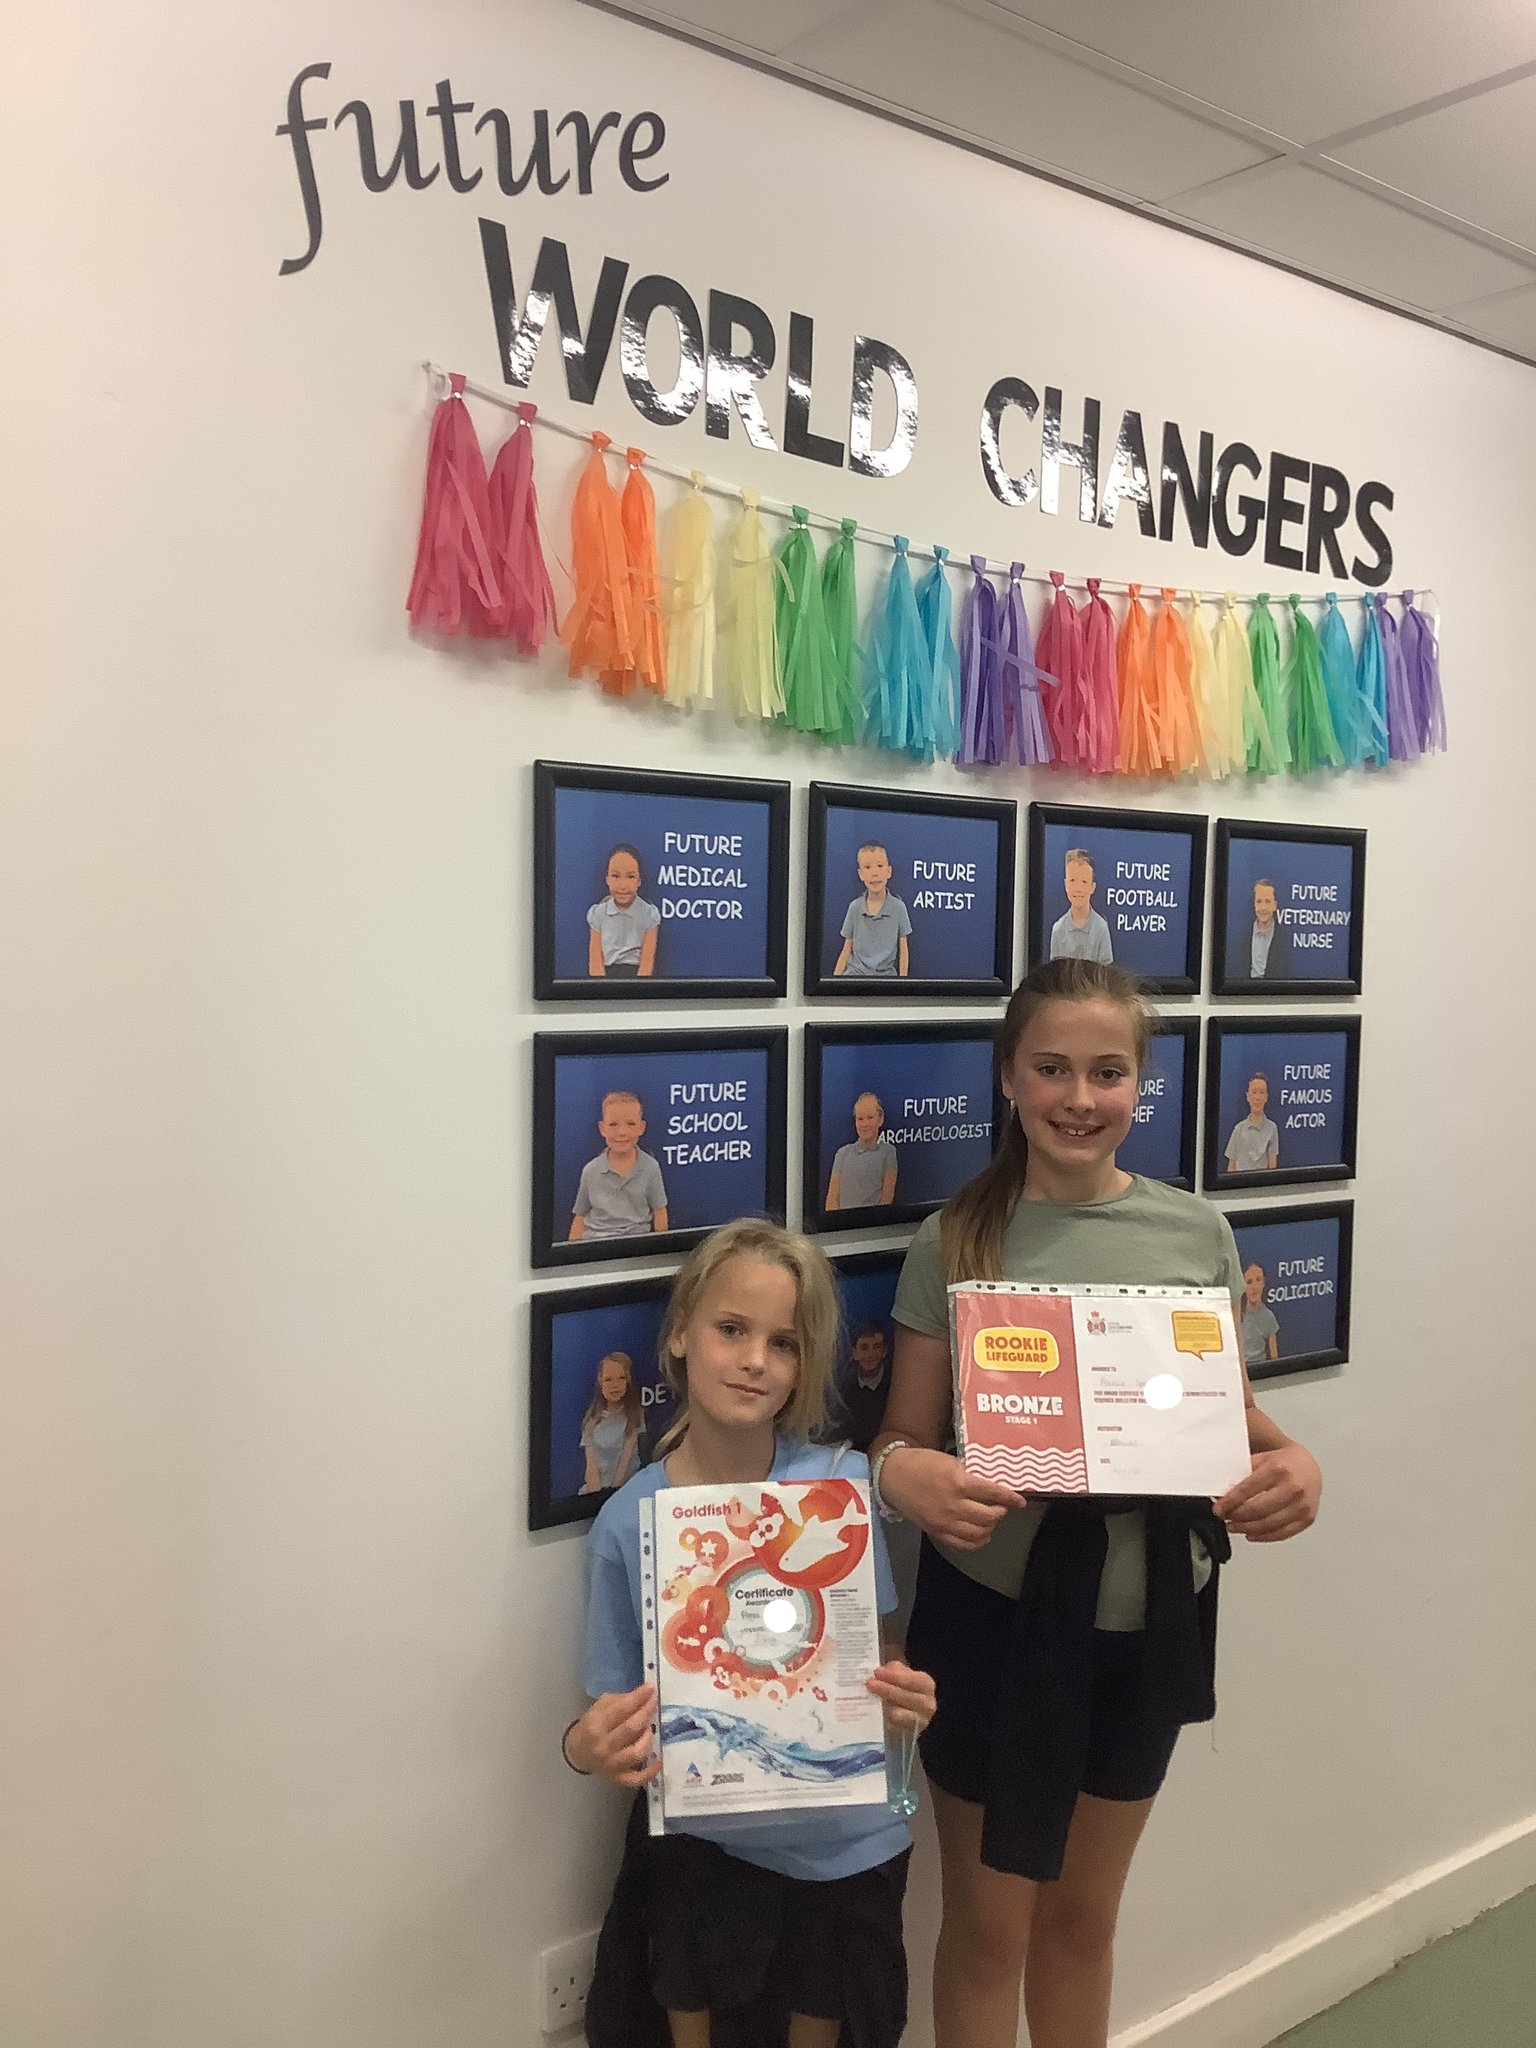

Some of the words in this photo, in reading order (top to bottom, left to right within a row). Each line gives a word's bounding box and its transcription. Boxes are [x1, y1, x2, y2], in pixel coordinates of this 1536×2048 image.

[275, 62, 669, 276] future
[478, 216, 919, 478] WORLD
[979, 377, 1394, 588] CHANGERS
[664, 831, 743, 857] FUTURE
[657, 865, 748, 889] MEDICAL
[913, 860, 976, 883] FUTURE
[1116, 861, 1171, 882] FUTURE
[913, 891, 975, 911] ARTIST
[1107, 887, 1178, 908] FOOTBALL
[1291, 883, 1338, 902] FUTURE
[661, 897, 743, 920] DOCTOR
[1276, 908, 1351, 926] VETERINARY
[1117, 913, 1166, 932] PLAYER
[1293, 932, 1334, 949] NURSE
[1284, 1063, 1332, 1081] FUTURE
[670, 1080, 747, 1105] FUTURE
[1138, 1078, 1165, 1096] URE
[1280, 1088, 1333, 1106] FAMOUS
[904, 1095, 968, 1118] FUTURE
[1131, 1105, 1155, 1123] HEF
[667, 1111, 748, 1135] SCHOOL
[1285, 1112, 1326, 1129] ACTOR
[876, 1122, 993, 1145] ARCHAEOLOGIST
[663, 1140, 752, 1165] TEACHER
[1278, 1256, 1325, 1278] FUTURE
[1267, 1279, 1334, 1303] SOLICITOR
[984, 1335, 1048, 1351] ROOKIE
[985, 1351, 1048, 1363] LIFEGUARD
[976, 1392, 1064, 1416] BRONZE
[672, 1503, 732, 1519] Goldfish
[736, 1501, 741, 1515] 1
[734, 1586, 794, 1600] Certificate
